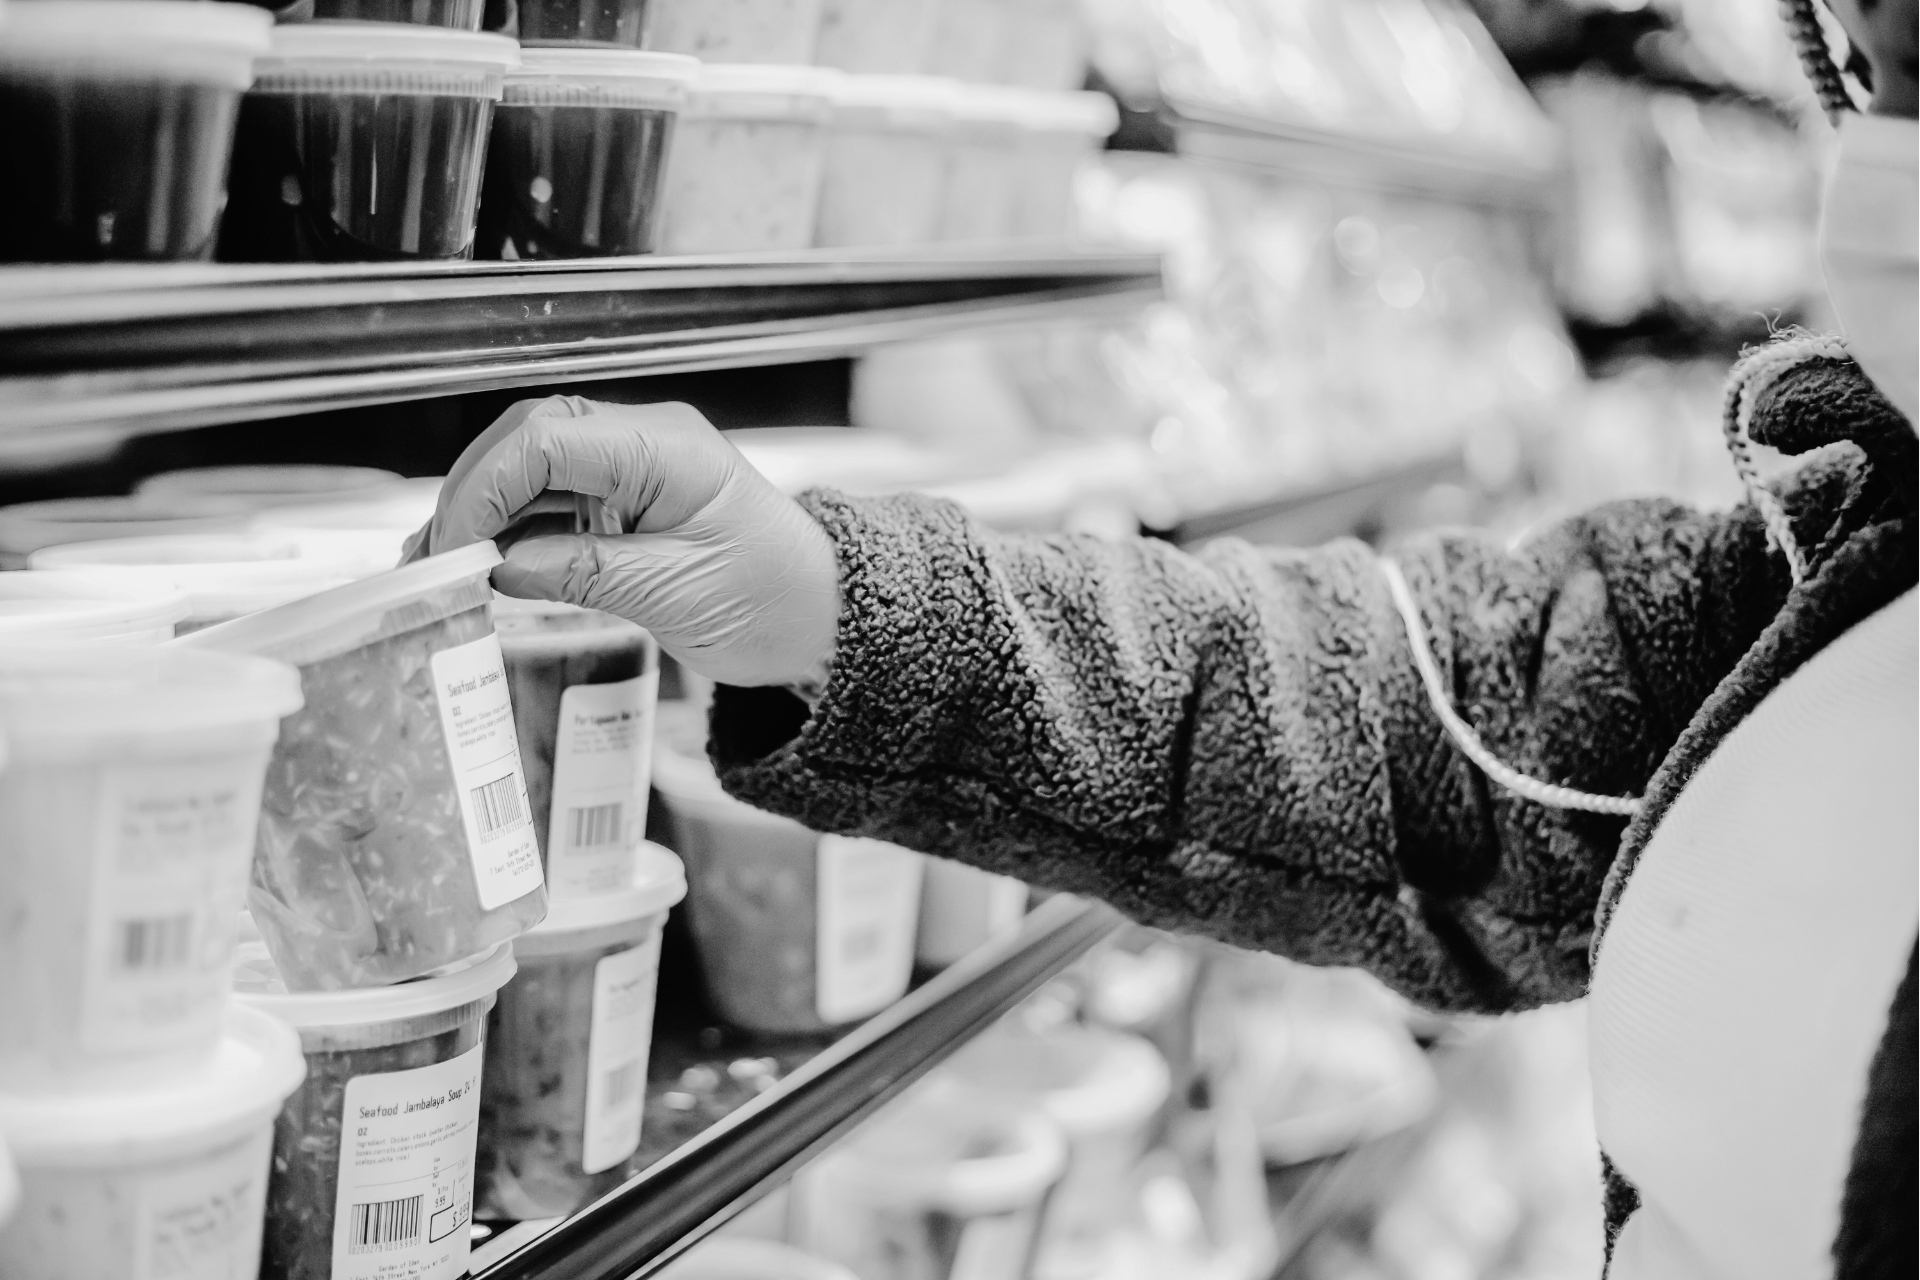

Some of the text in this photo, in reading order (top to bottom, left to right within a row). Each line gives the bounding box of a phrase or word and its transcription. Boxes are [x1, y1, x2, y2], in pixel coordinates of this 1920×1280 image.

[447, 676, 477, 698] Seafood
[358, 1102, 399, 1119] Seafood
[403, 1095, 445, 1114] Jambalaya
[448, 1089, 462, 1102] Soup
[390, 1135, 411, 1145] Chicken
[412, 1131, 427, 1140] stock
[379, 1264, 398, 1272] Garden
[408, 1259, 420, 1267] Eden
[387, 1271, 405, 1280] Street
